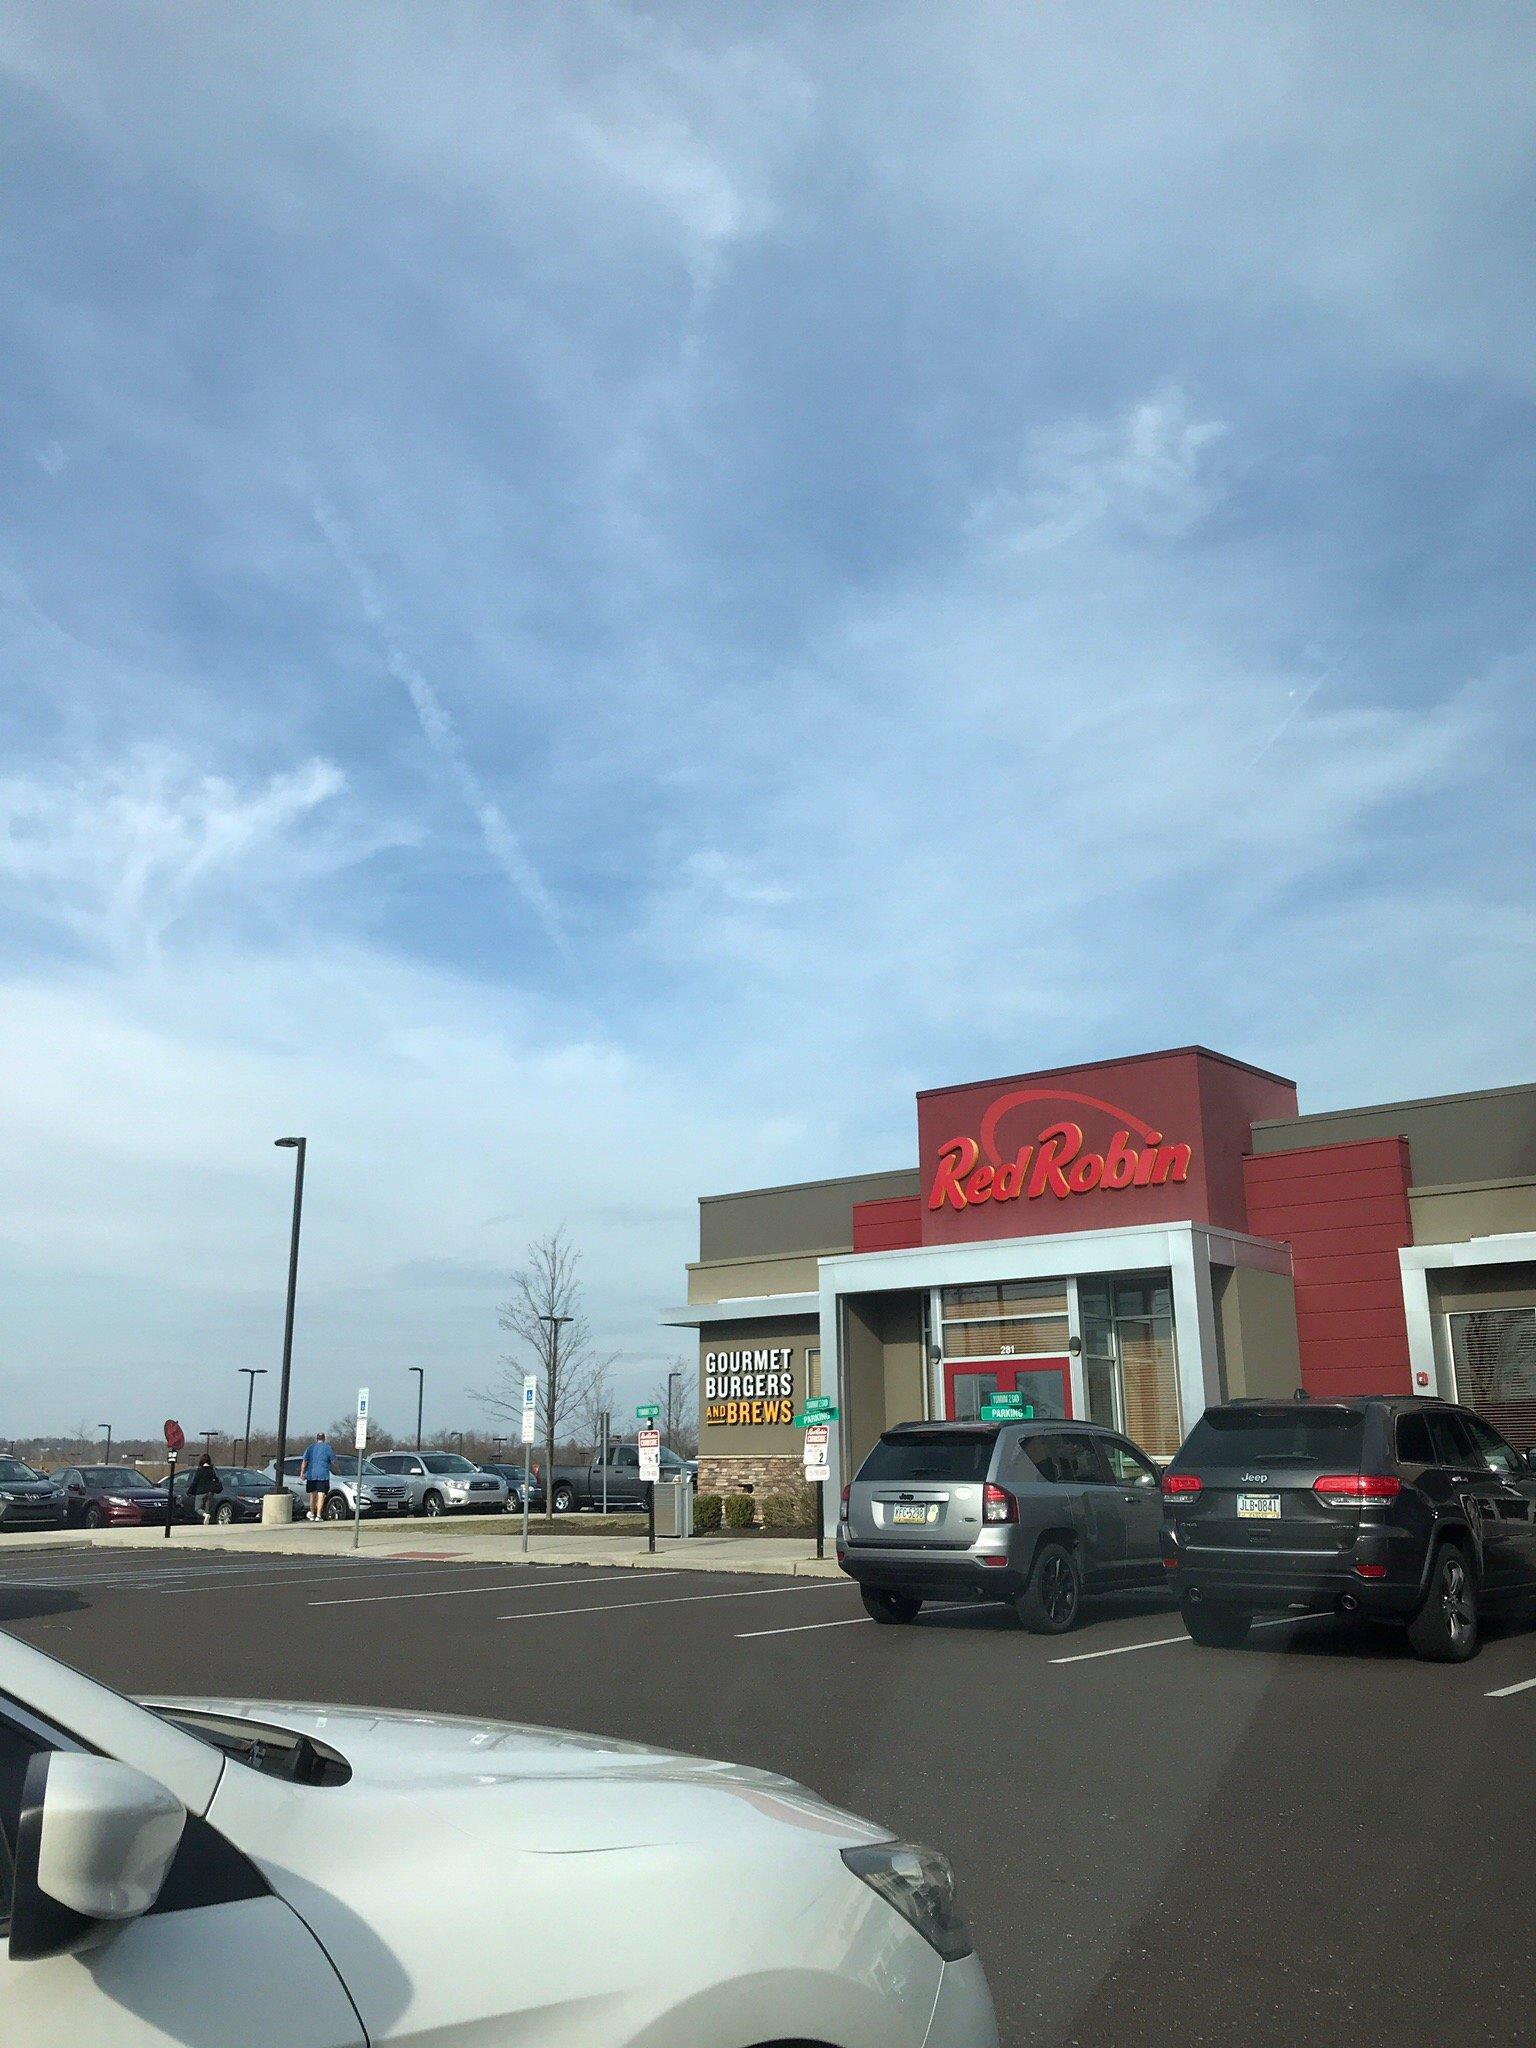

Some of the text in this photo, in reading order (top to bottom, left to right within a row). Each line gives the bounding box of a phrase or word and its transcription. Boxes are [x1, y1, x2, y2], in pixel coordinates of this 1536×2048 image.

[928, 1122, 1192, 1211] Red Robin
[1000, 1345, 1015, 1354] 281
[705, 1348, 792, 1374] GOURMET
[705, 1373, 793, 1399] BURGERS
[706, 1405, 726, 1419] AND
[727, 1399, 793, 1425] BREWS
[803, 1411, 830, 1424] PARKING
[992, 1408, 1023, 1418] PARKING
[819, 1452, 824, 1463] 2
[1241, 1472, 1268, 1484] Jeep
